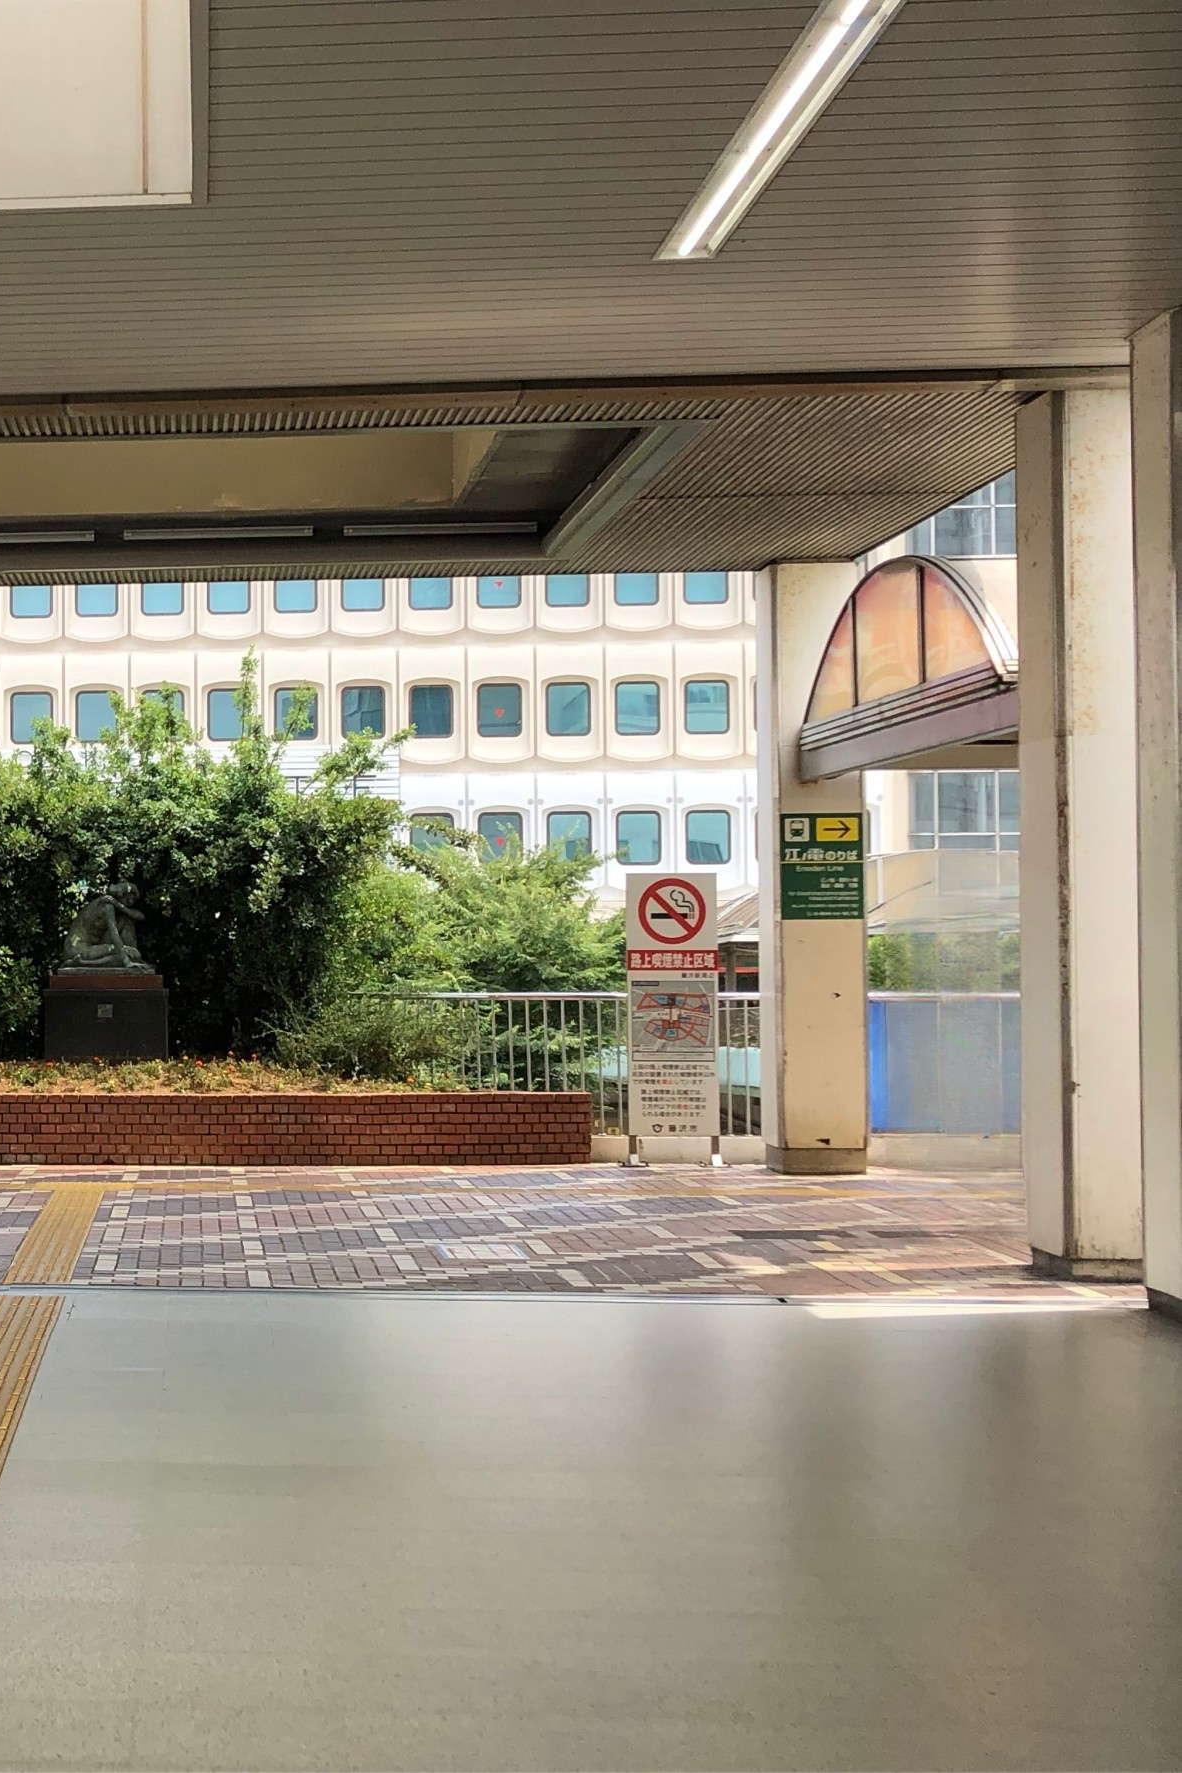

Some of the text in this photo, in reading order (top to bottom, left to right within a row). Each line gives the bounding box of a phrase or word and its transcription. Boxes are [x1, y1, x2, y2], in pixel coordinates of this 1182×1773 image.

[784, 848, 858, 861] 江ノ電のりば
[630, 953, 715, 969] 路上喫煙禁止区域
